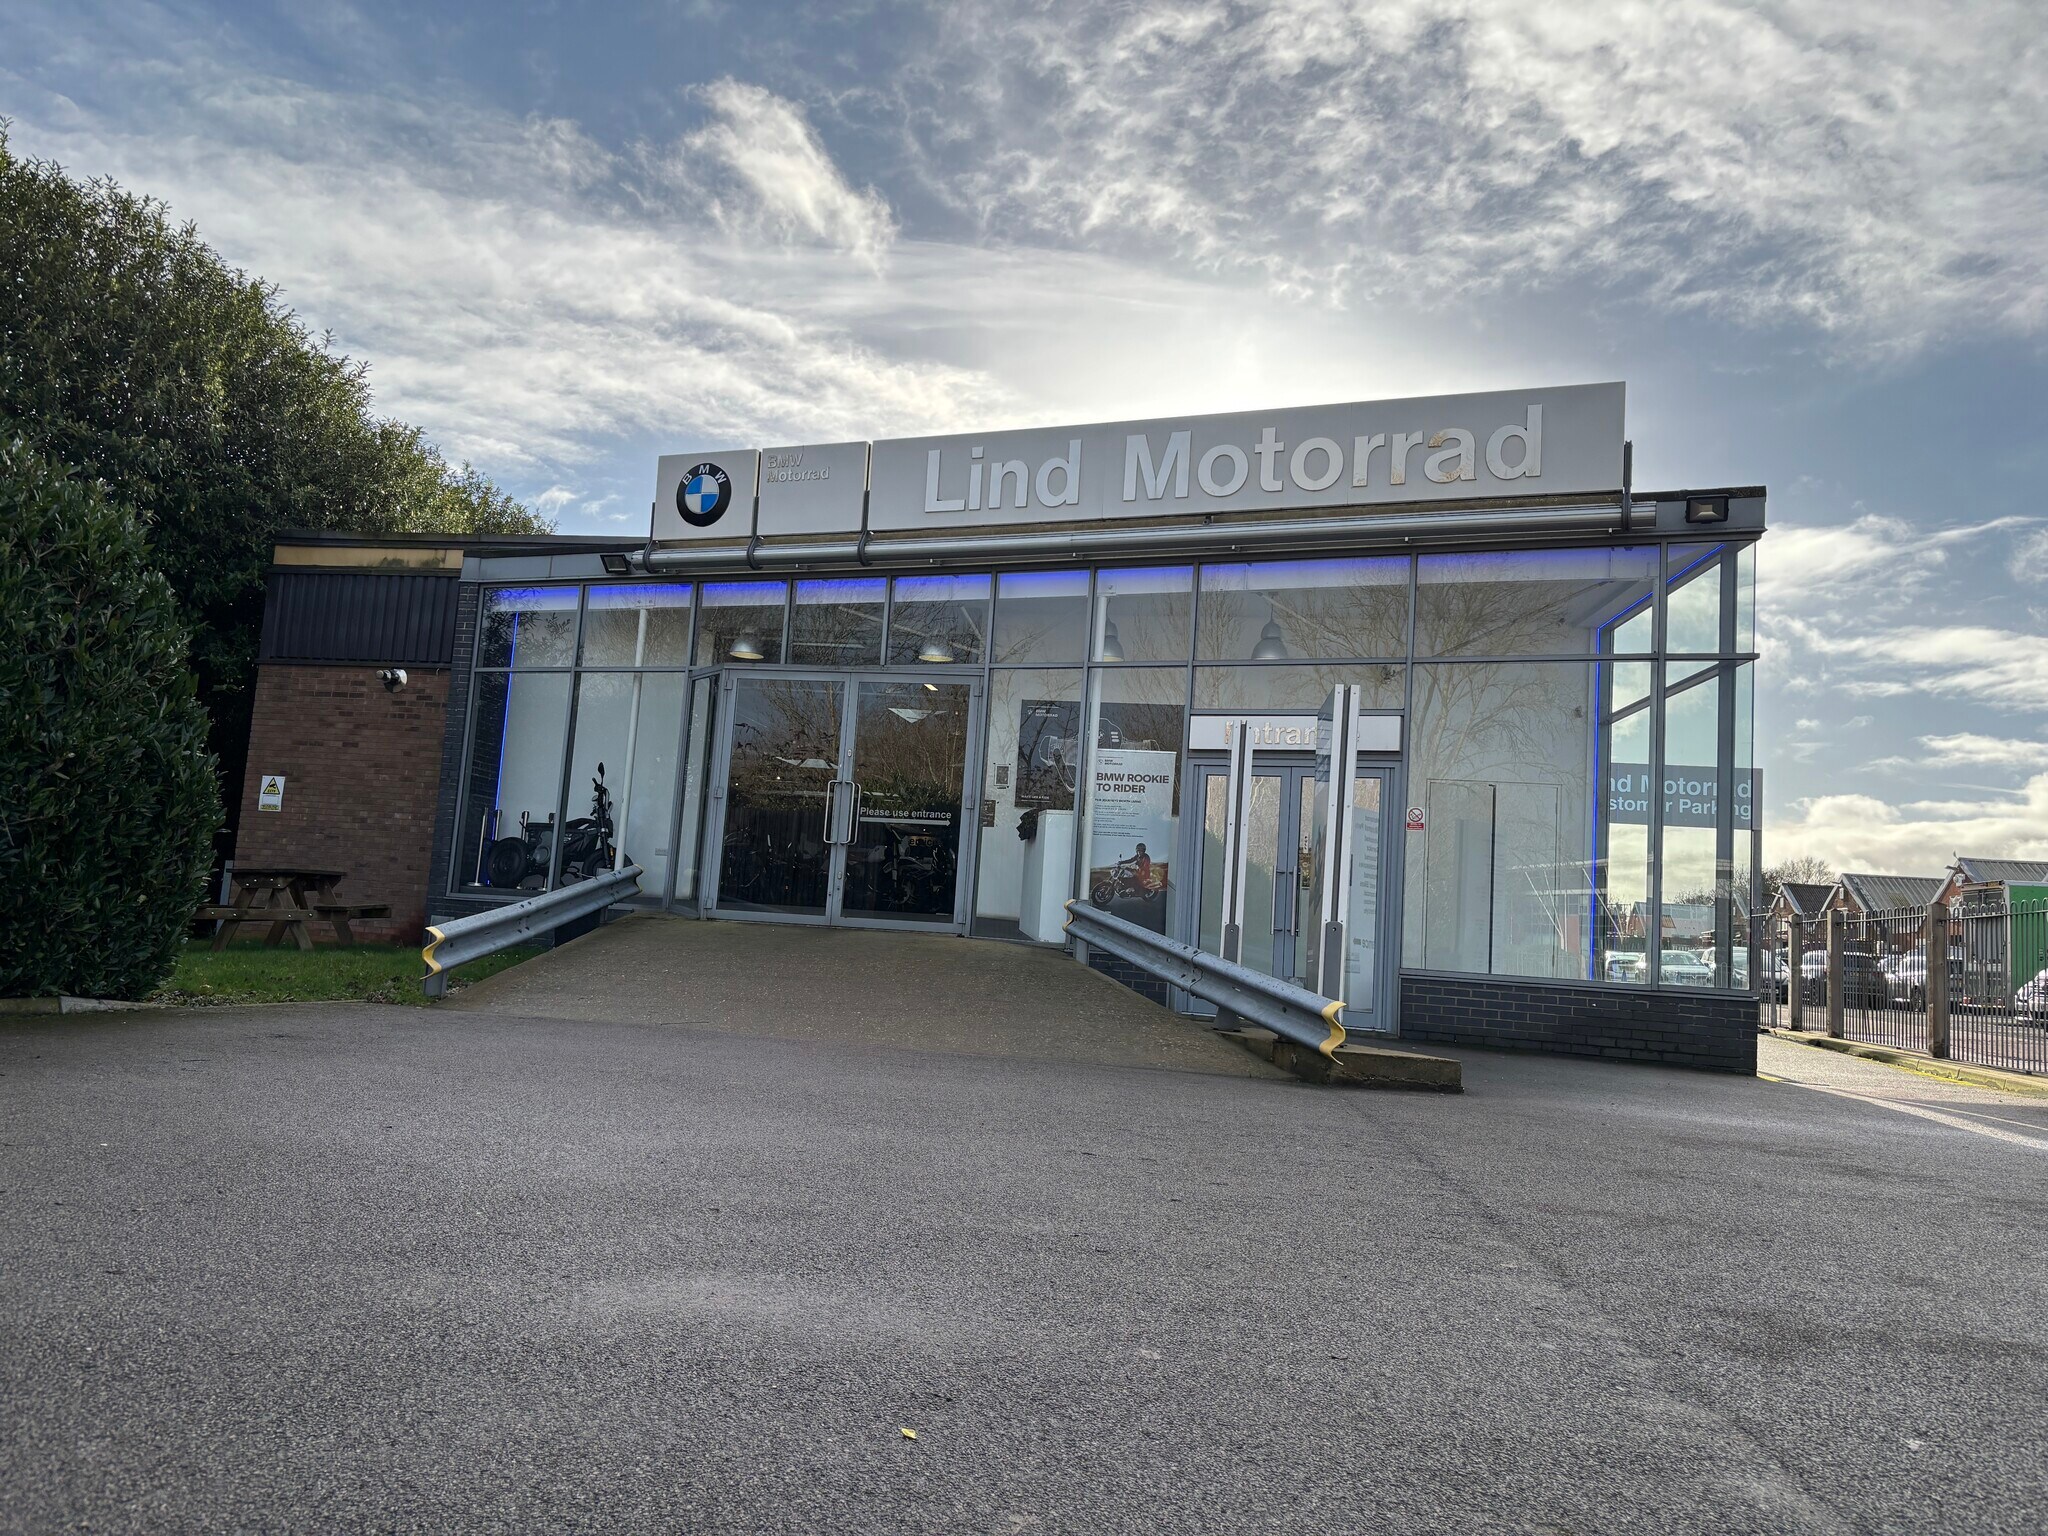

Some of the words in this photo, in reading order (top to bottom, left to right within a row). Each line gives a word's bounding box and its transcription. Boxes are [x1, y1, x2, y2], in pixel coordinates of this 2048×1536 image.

[767, 453, 804, 469] BMW
[924, 438, 1082, 513] Lind
[1122, 403, 1543, 501] Motorrad
[682, 464, 727, 485] BMW
[767, 466, 830, 482] Motorrad
[1096, 772, 1125, 782] BMW
[1127, 773, 1170, 784] ROOKIE
[1096, 783, 1111, 792] TO
[1113, 783, 1146, 793] RIDER
[860, 806, 890, 817] Please
[892, 809, 909, 818] use
[911, 810, 952, 819] entrance
